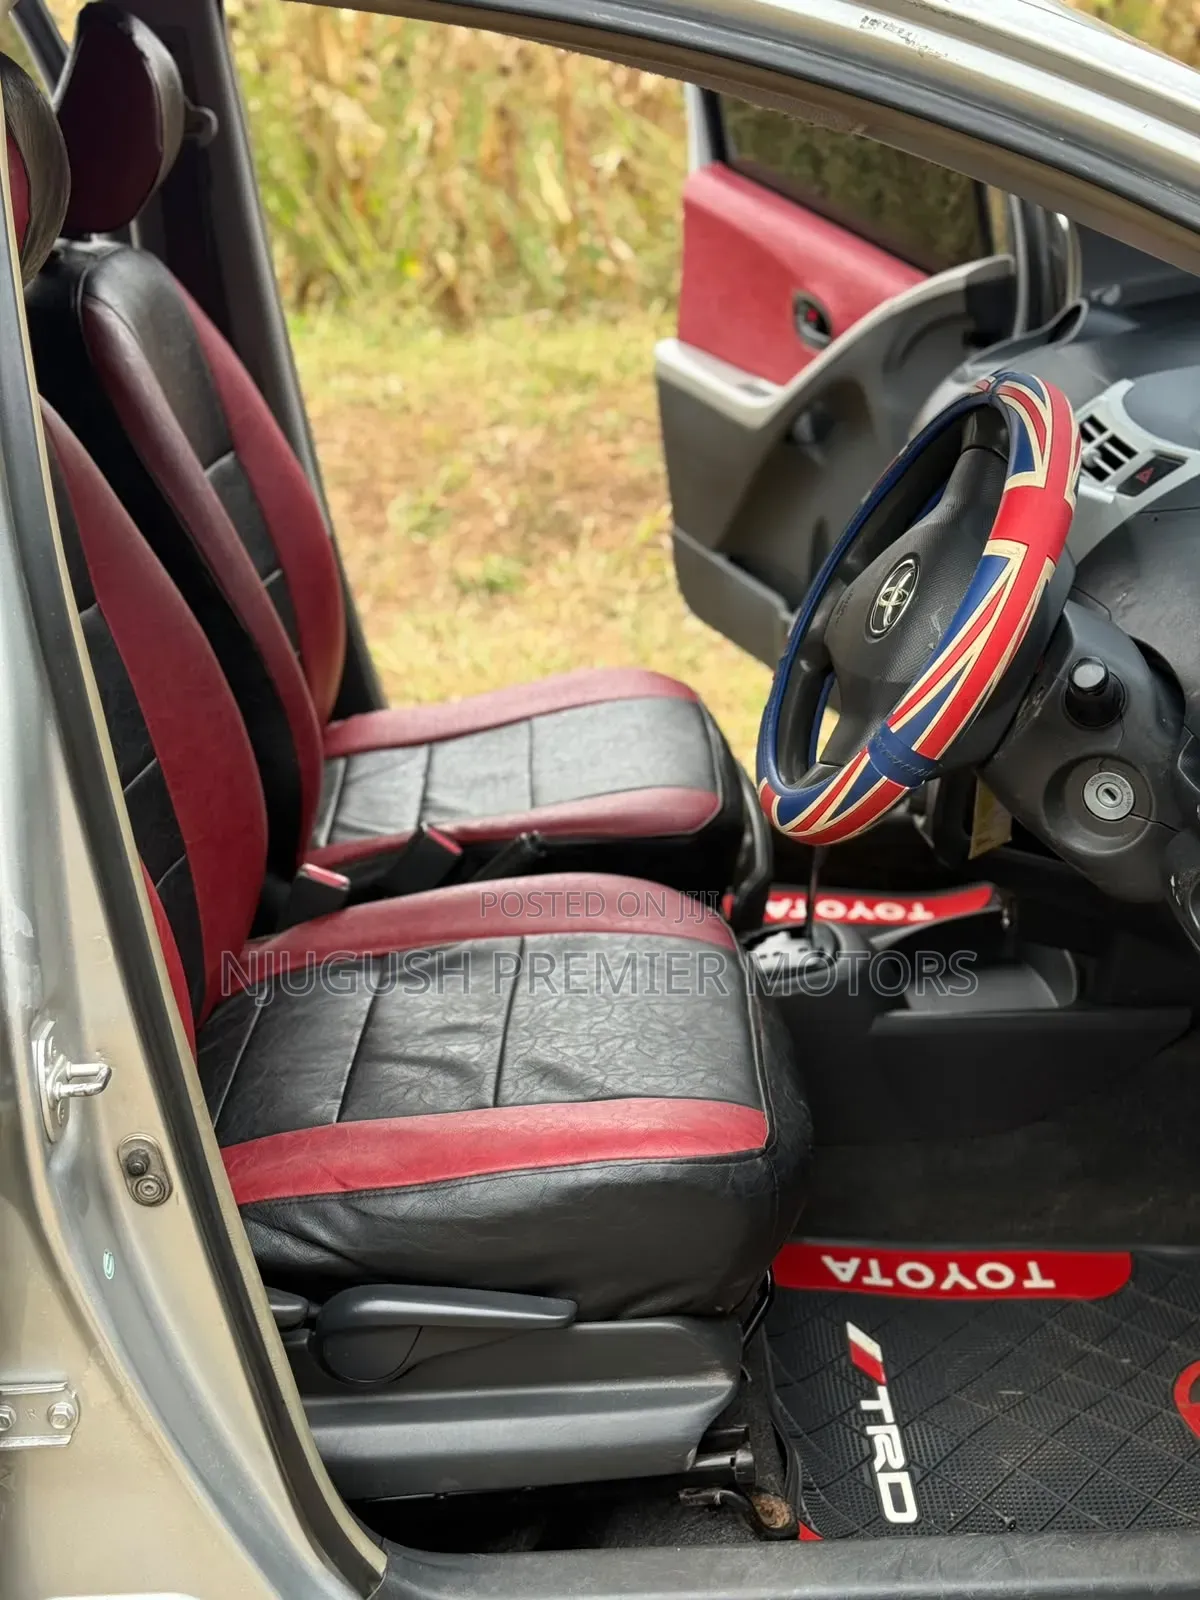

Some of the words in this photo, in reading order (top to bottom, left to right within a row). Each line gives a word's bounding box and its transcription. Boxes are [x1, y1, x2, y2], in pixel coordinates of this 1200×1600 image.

[765, 898, 935, 921] TOYOTA
[821, 1255, 1057, 1290] TOYOTA
[860, 1386, 919, 1524] TRD
